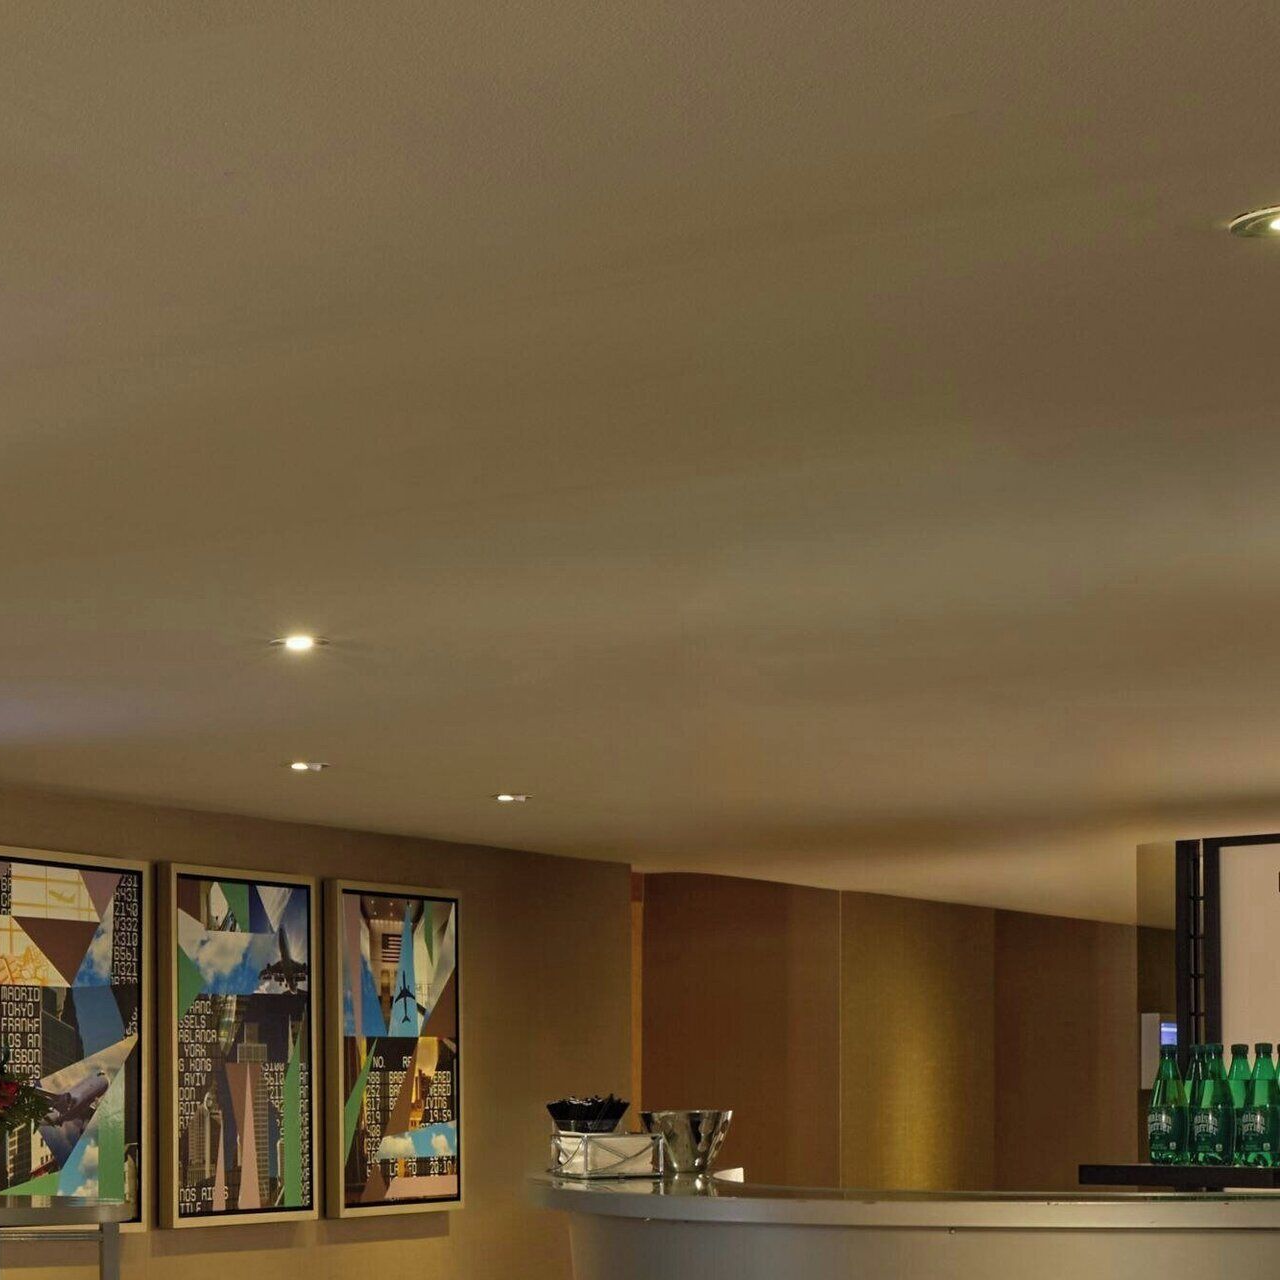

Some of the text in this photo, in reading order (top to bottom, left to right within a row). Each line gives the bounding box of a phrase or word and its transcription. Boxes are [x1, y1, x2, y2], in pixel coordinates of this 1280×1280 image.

[1, 987, 40, 1001] MADRID
[1, 1002, 34, 1017] TOKYO
[184, 1073, 206, 1086] AVIV
